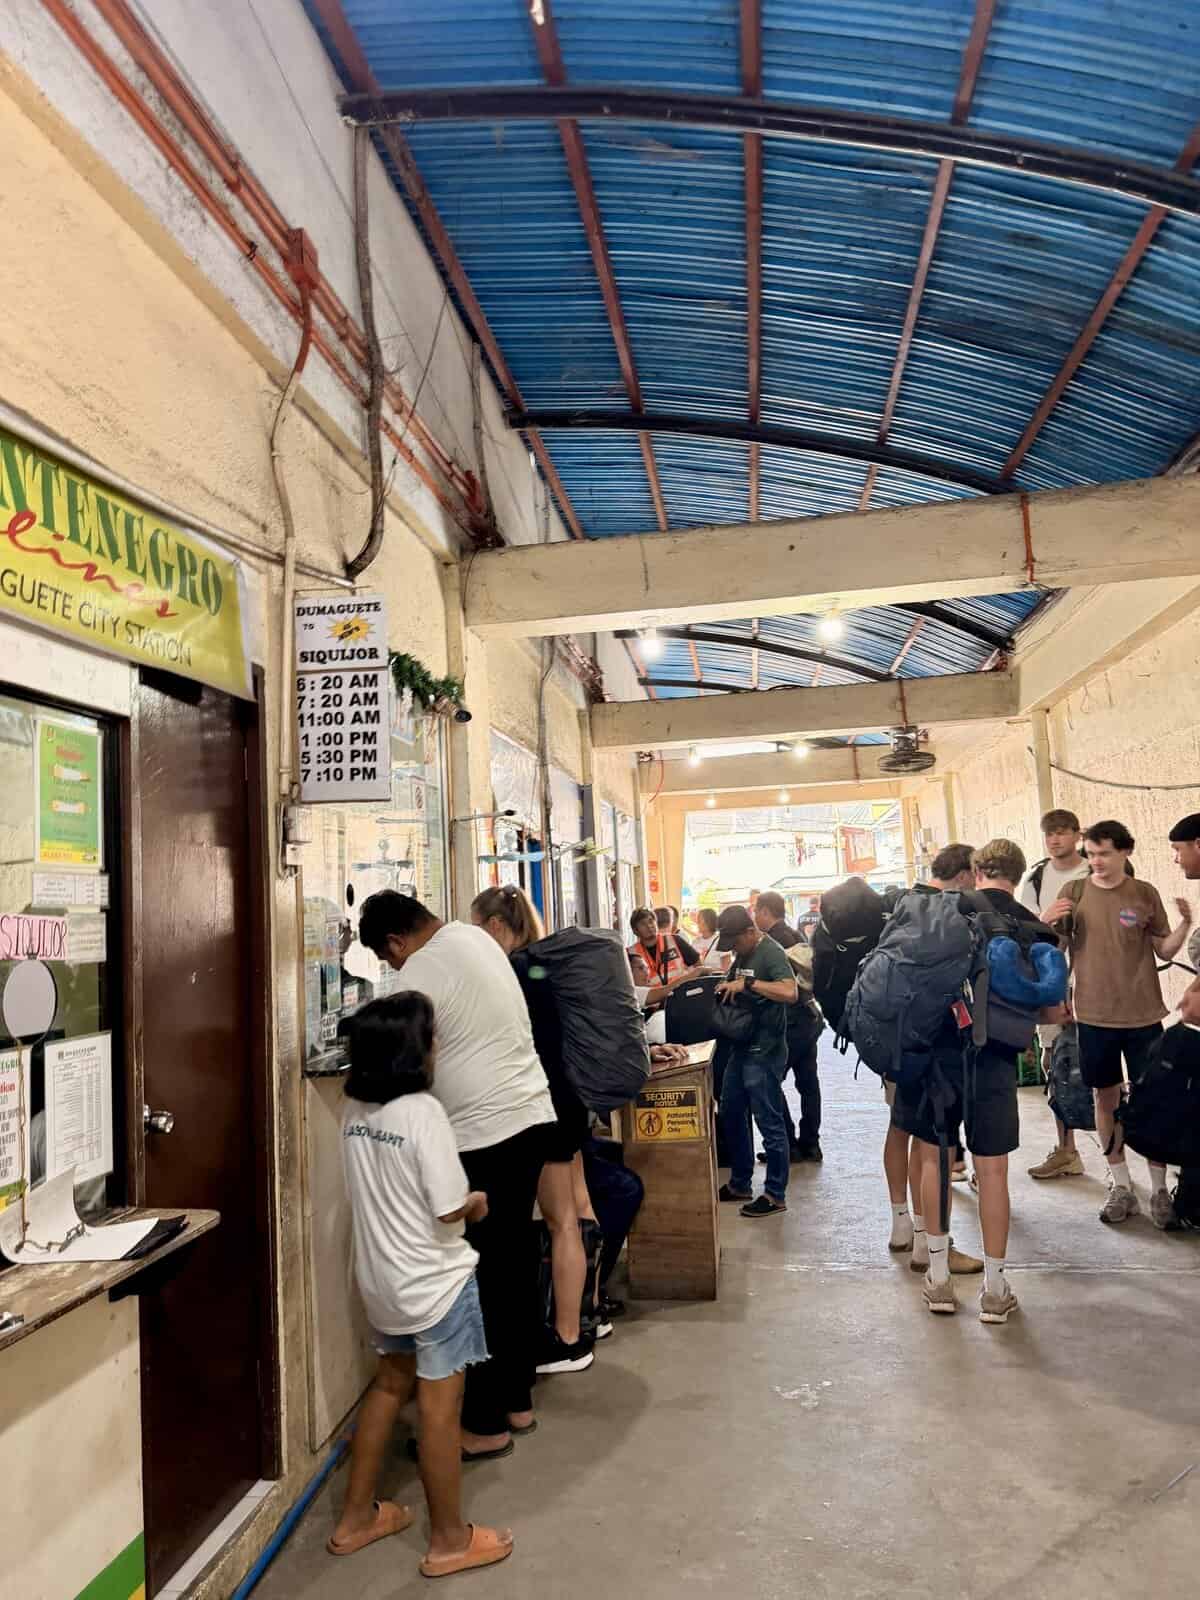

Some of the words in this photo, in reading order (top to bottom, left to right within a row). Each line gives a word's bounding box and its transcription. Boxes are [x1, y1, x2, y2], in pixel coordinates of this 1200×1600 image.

[296, 602, 381, 616] DUMAGUETE
[0, 568, 73, 620] GUETE
[79, 600, 120, 638] CITY
[125, 620, 192, 666] STATION
[299, 647, 379, 664] SIQUIJOR
[349, 673, 378, 688] AM
[349, 692, 378, 706] AM
[298, 711, 344, 728] 11:00
[351, 710, 380, 724] AM
[350, 731, 377, 745] PM
[350, 749, 377, 763] PM
[350, 767, 376, 781] PM
[646, 1092, 685, 1101] SECURITY
